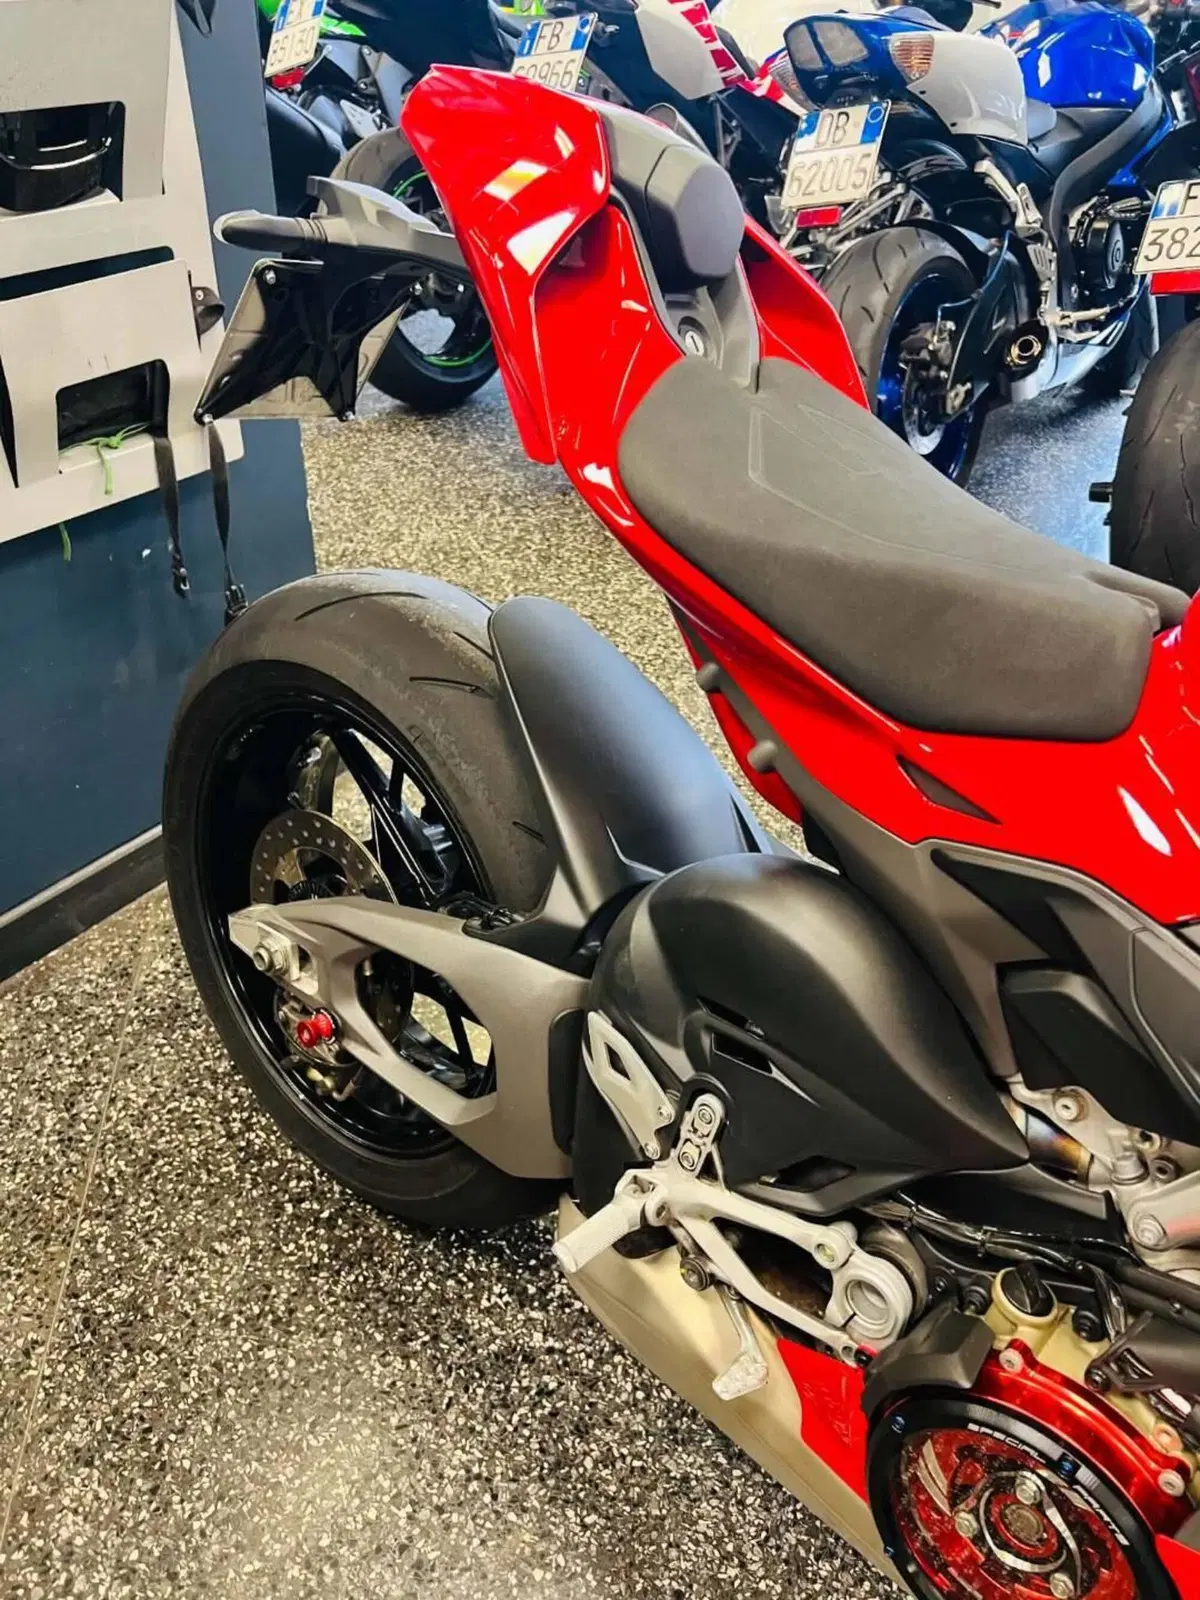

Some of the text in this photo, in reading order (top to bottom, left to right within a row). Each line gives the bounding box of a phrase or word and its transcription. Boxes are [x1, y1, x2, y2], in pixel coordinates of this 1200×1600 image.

[534, 21, 565, 53] FB
[787, 152, 872, 198] 62005
[966, 1422, 1047, 1464] SPECIAL
